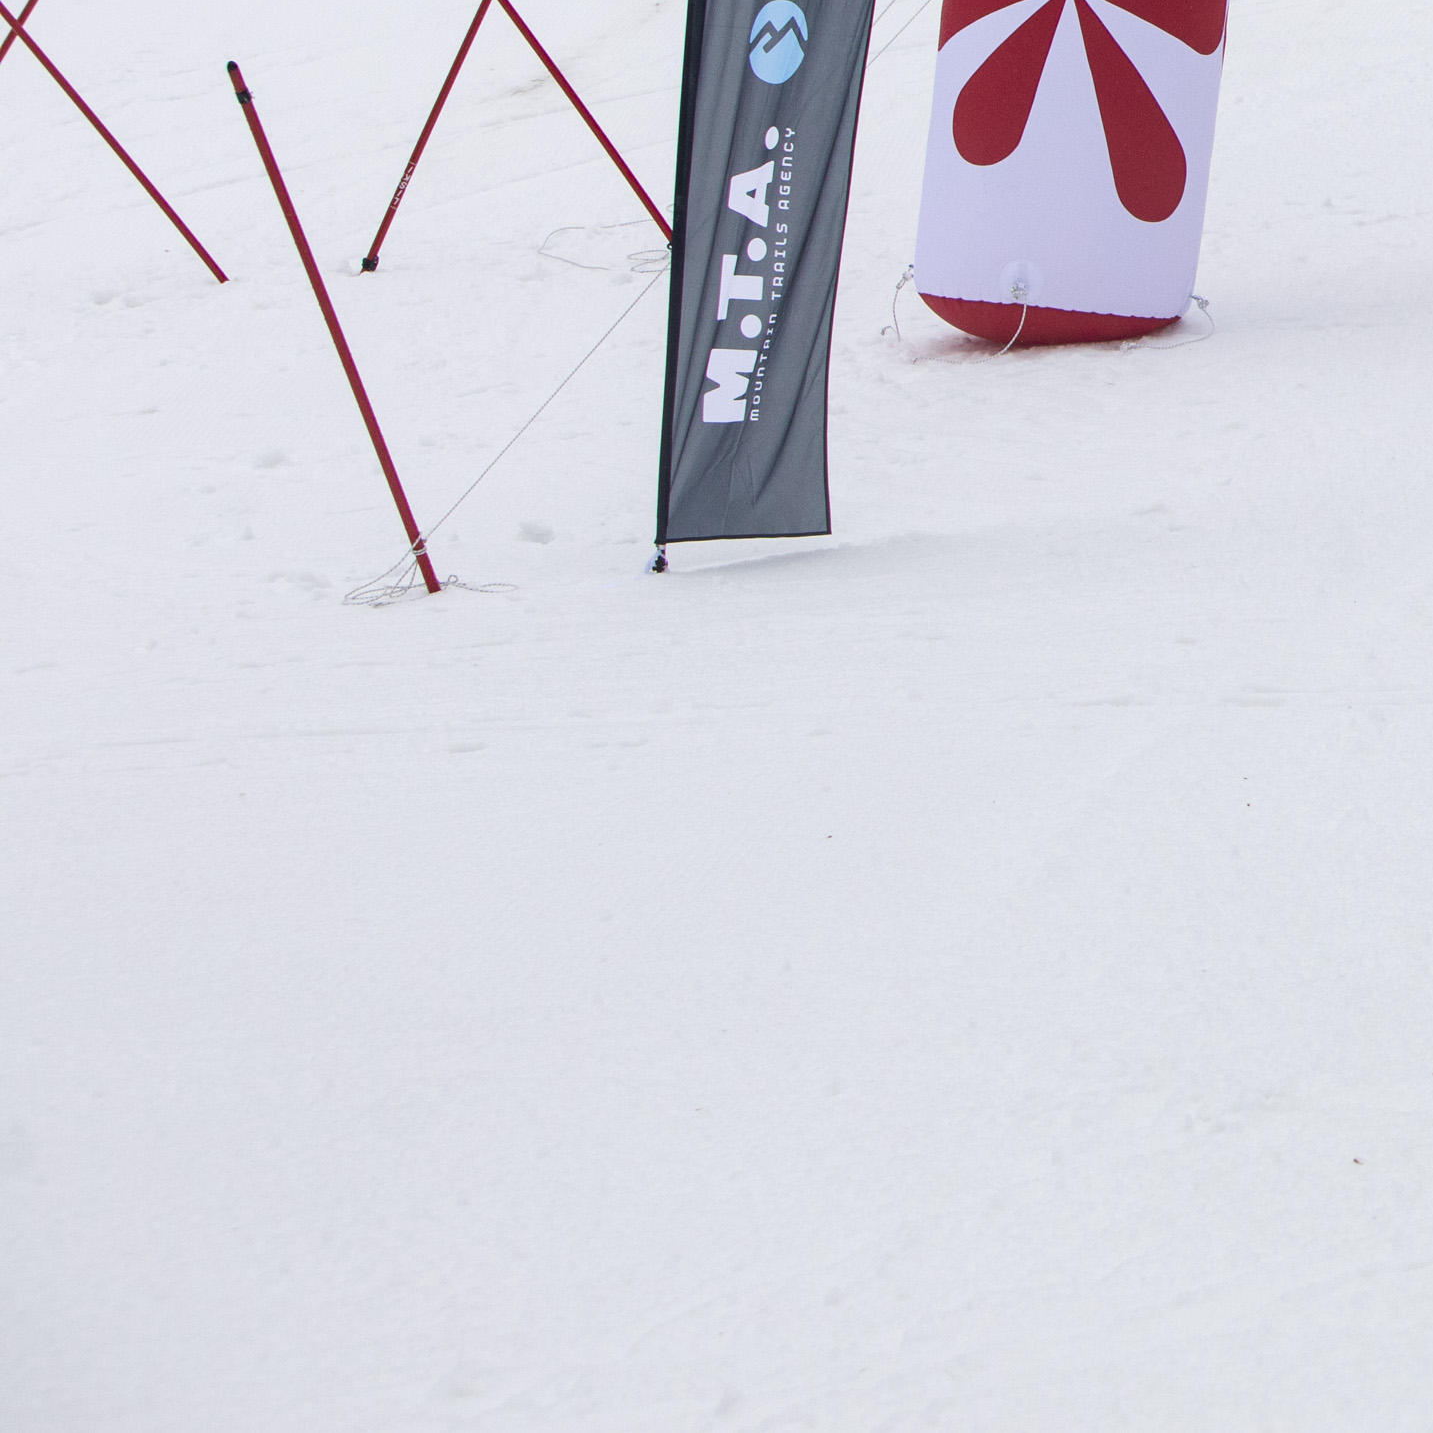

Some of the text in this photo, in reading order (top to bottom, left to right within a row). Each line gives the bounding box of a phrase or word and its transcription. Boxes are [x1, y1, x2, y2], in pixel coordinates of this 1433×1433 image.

[778, 127, 796, 210] AGENCY
[702, 125, 780, 423] M.T.A.
[771, 222, 788, 301] TRAILS
